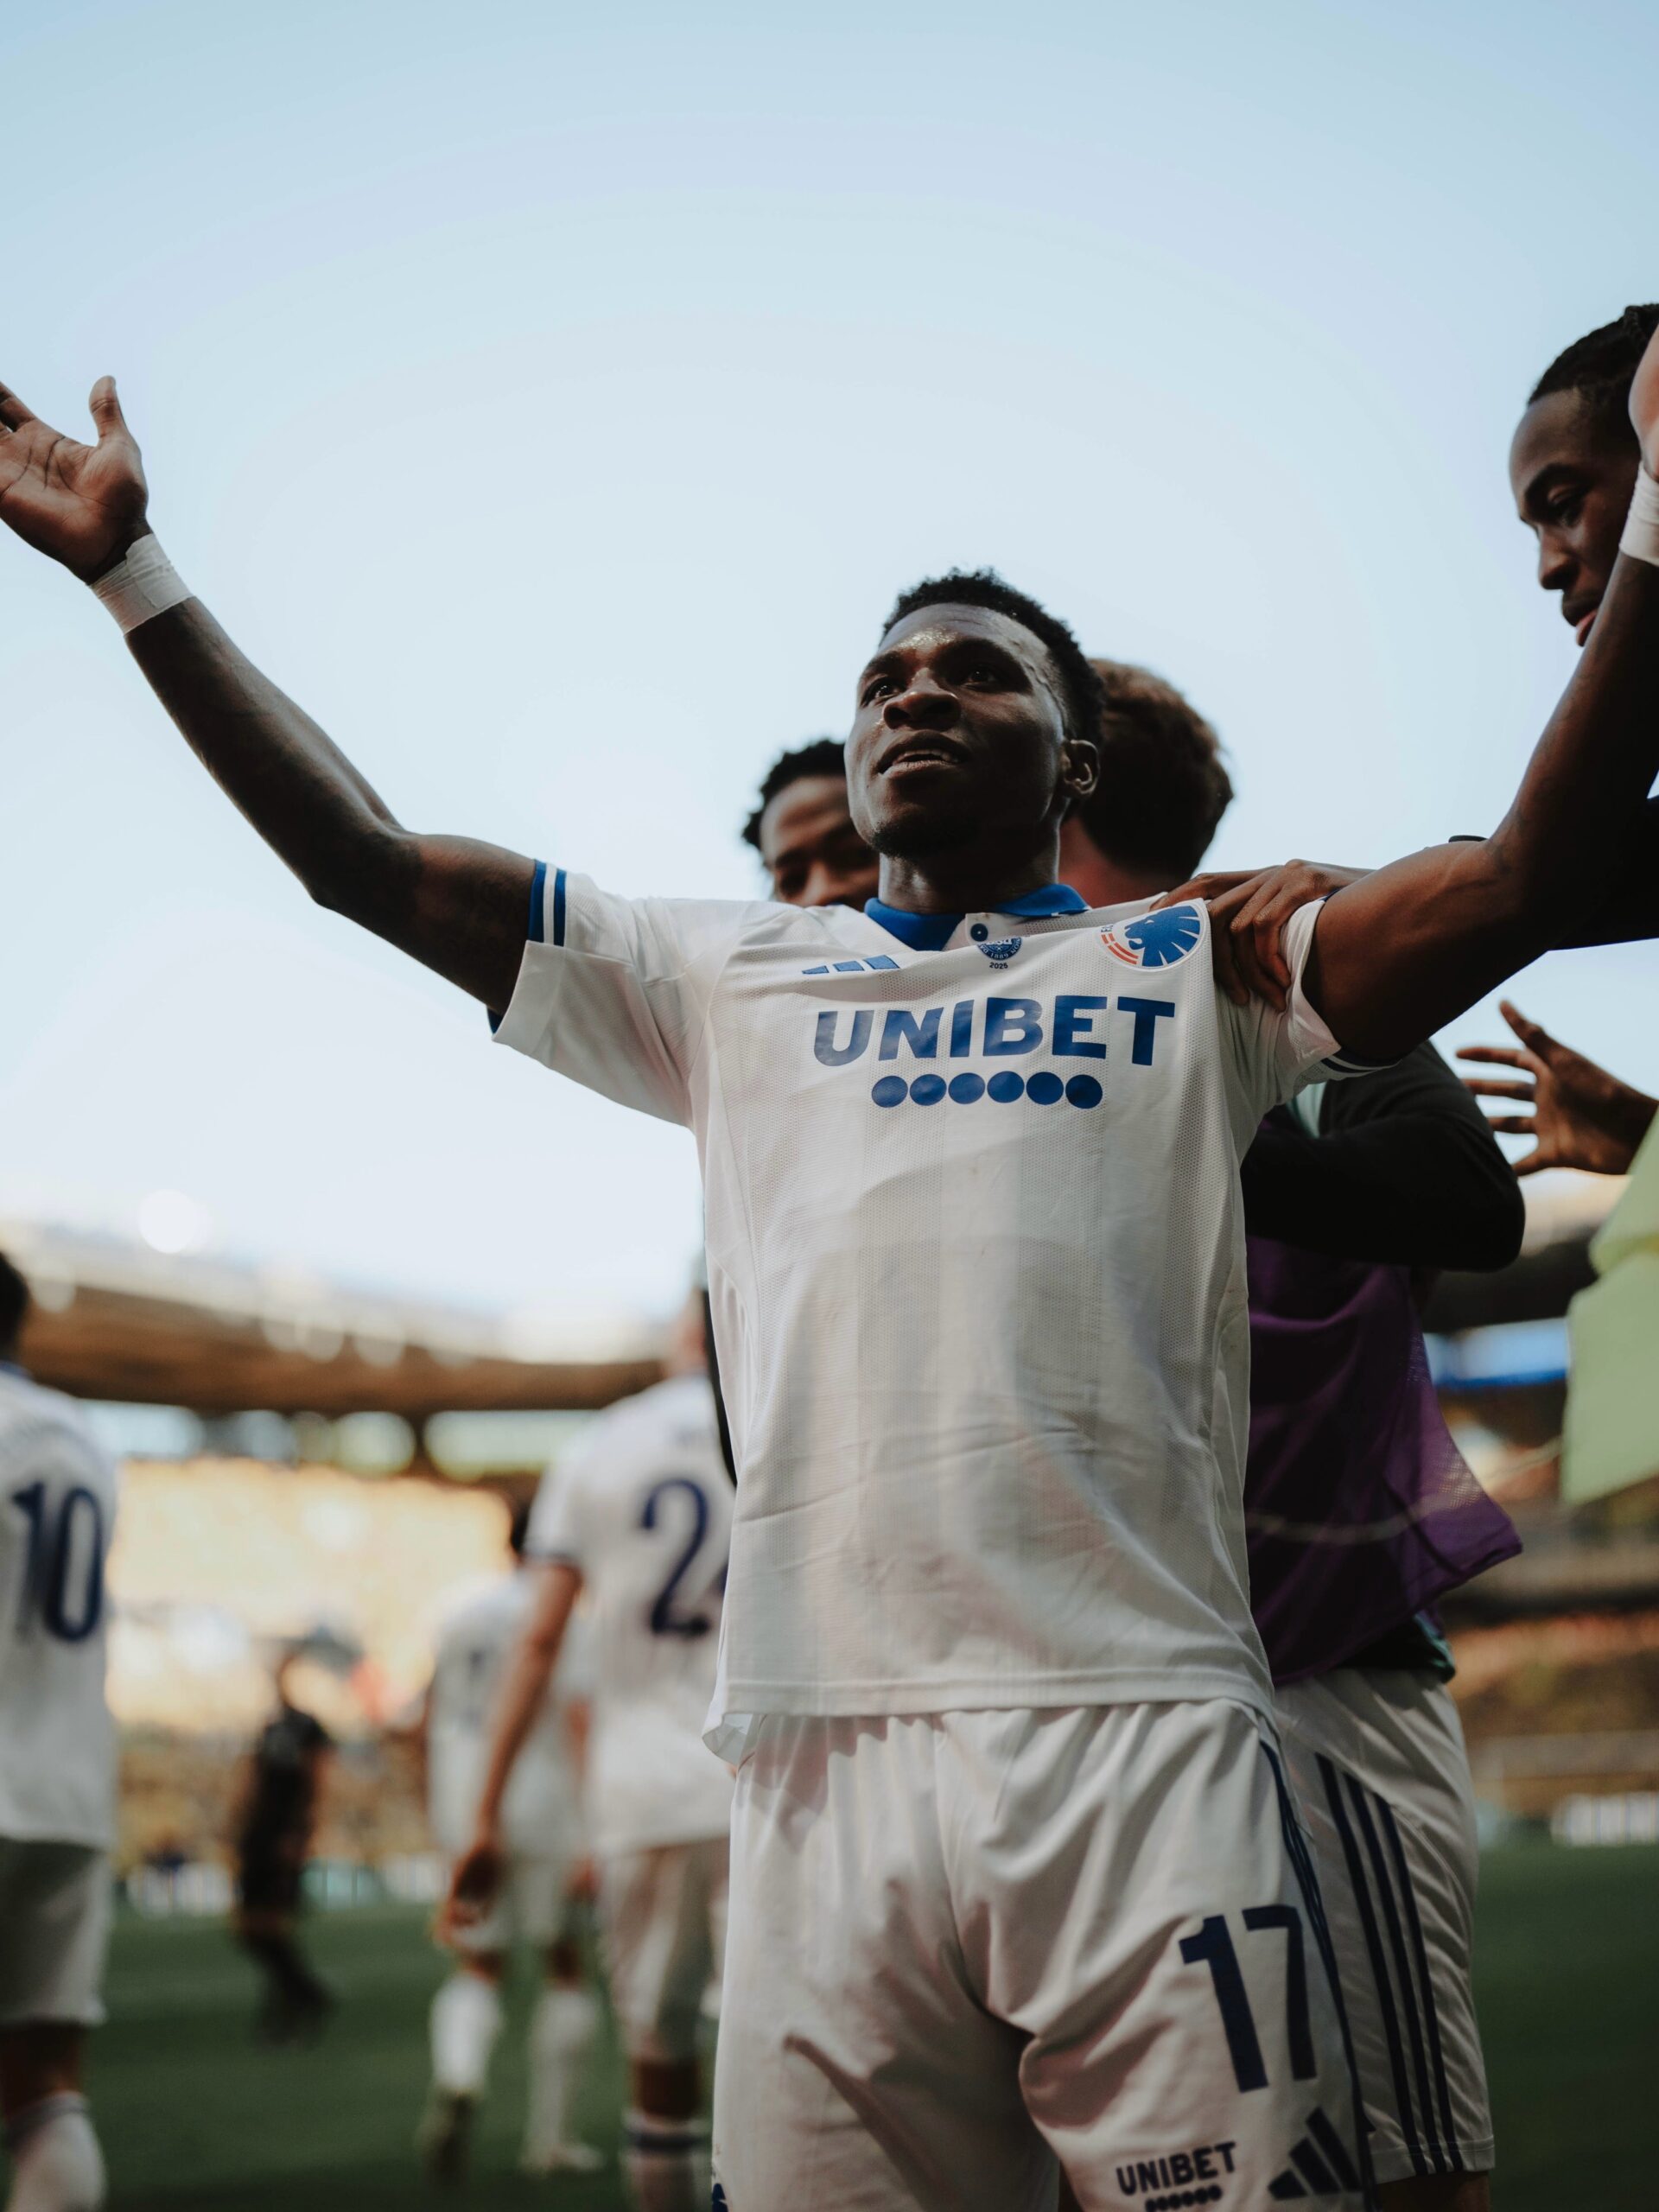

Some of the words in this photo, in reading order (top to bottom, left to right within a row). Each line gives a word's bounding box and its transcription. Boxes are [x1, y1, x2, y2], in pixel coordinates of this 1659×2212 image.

[813, 995, 1175, 1066] UNIBET
[12, 1481, 103, 1643] 10
[641, 1478, 729, 1636] 2
[1179, 1904, 1318, 2094] 17
[1116, 2141, 1236, 2196] UNIBET
